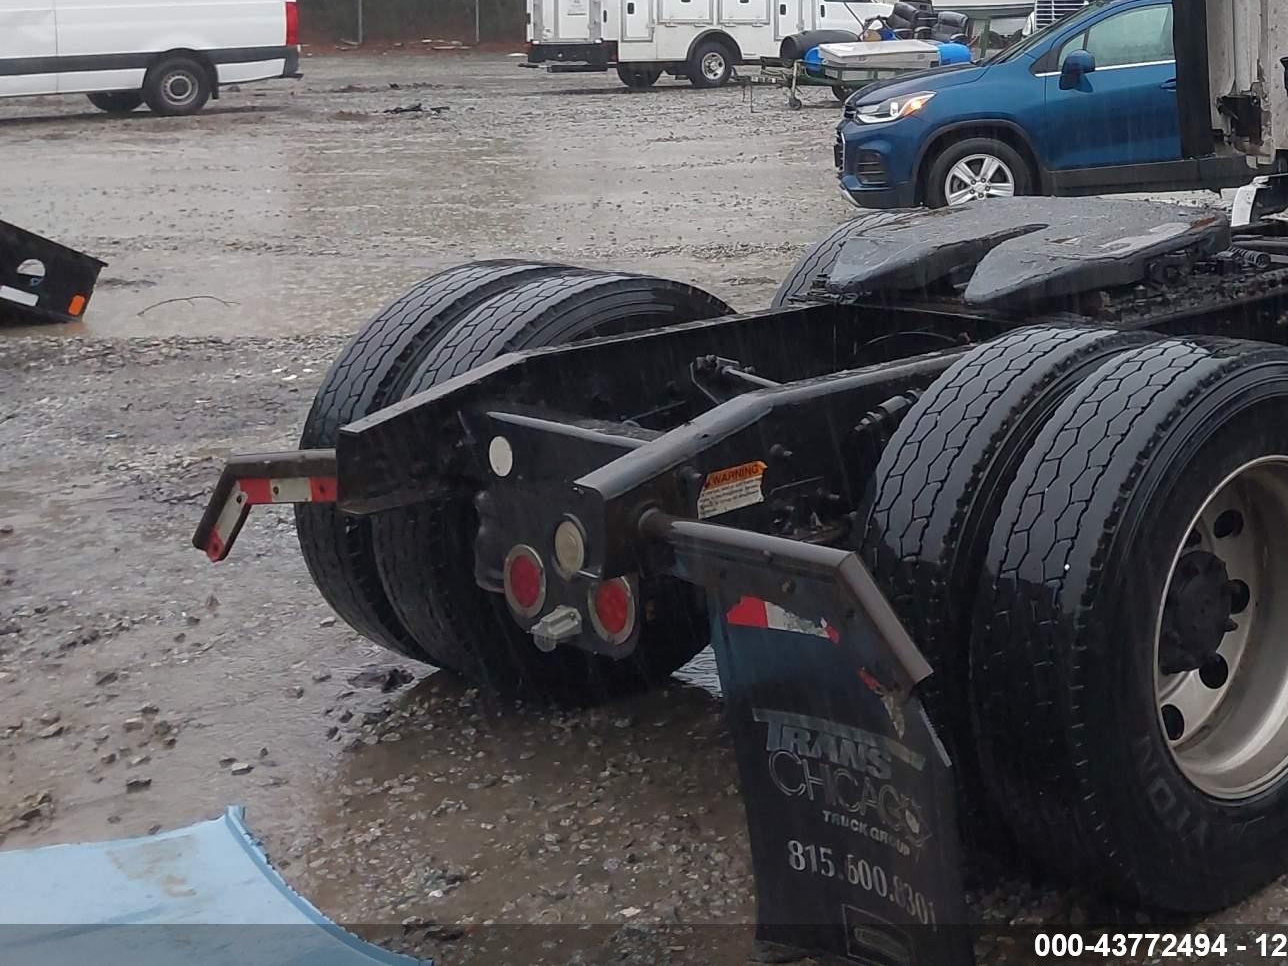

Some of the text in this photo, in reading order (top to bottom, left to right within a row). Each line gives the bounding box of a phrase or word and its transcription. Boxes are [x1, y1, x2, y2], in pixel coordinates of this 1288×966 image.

[712, 463, 760, 485] WARNING
[752, 708, 926, 780] TRANS
[822, 809, 911, 857] TRUCK GROUP
